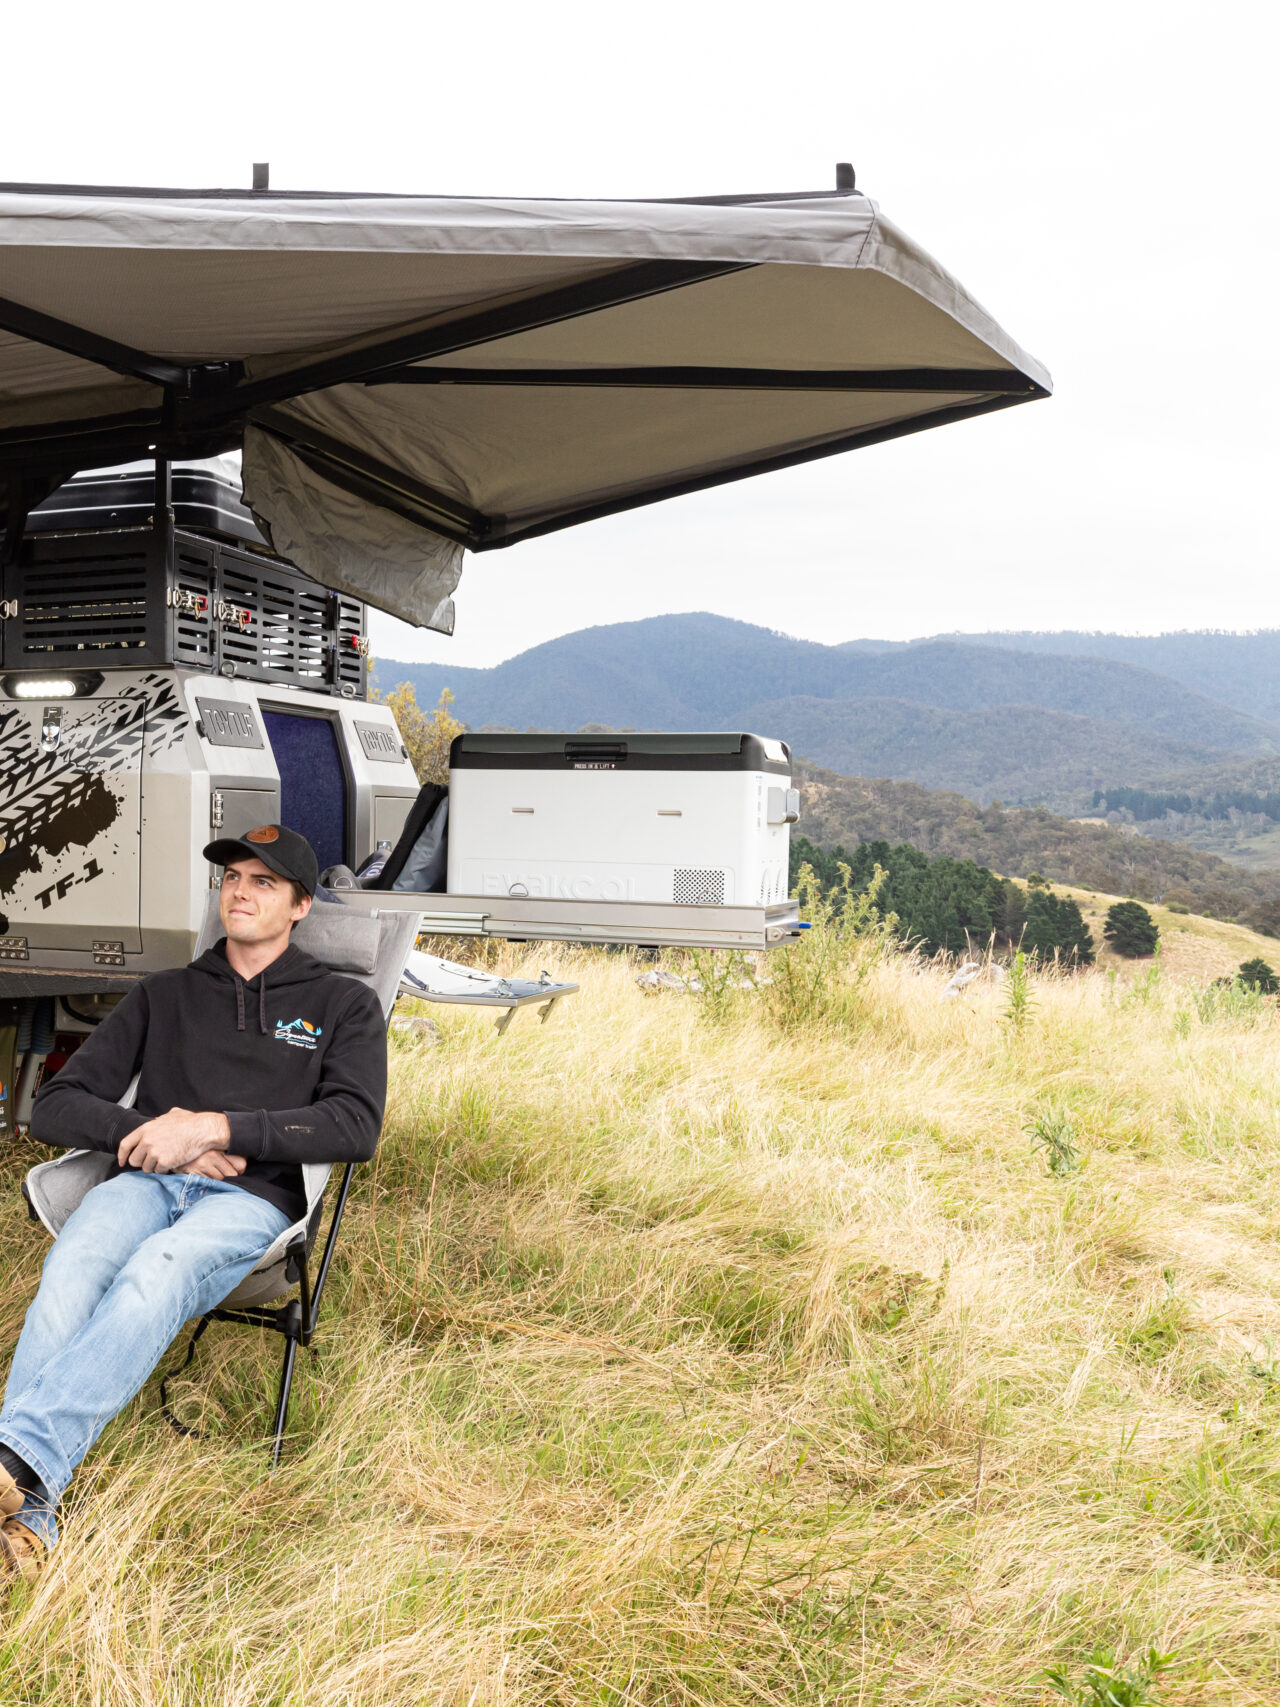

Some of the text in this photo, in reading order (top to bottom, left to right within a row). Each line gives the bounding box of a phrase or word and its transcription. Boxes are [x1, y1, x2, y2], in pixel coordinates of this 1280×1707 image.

[204, 708, 253, 738] TOYTUF
[360, 729, 397, 754] TOYTUF
[34, 858, 104, 910] TF-1
